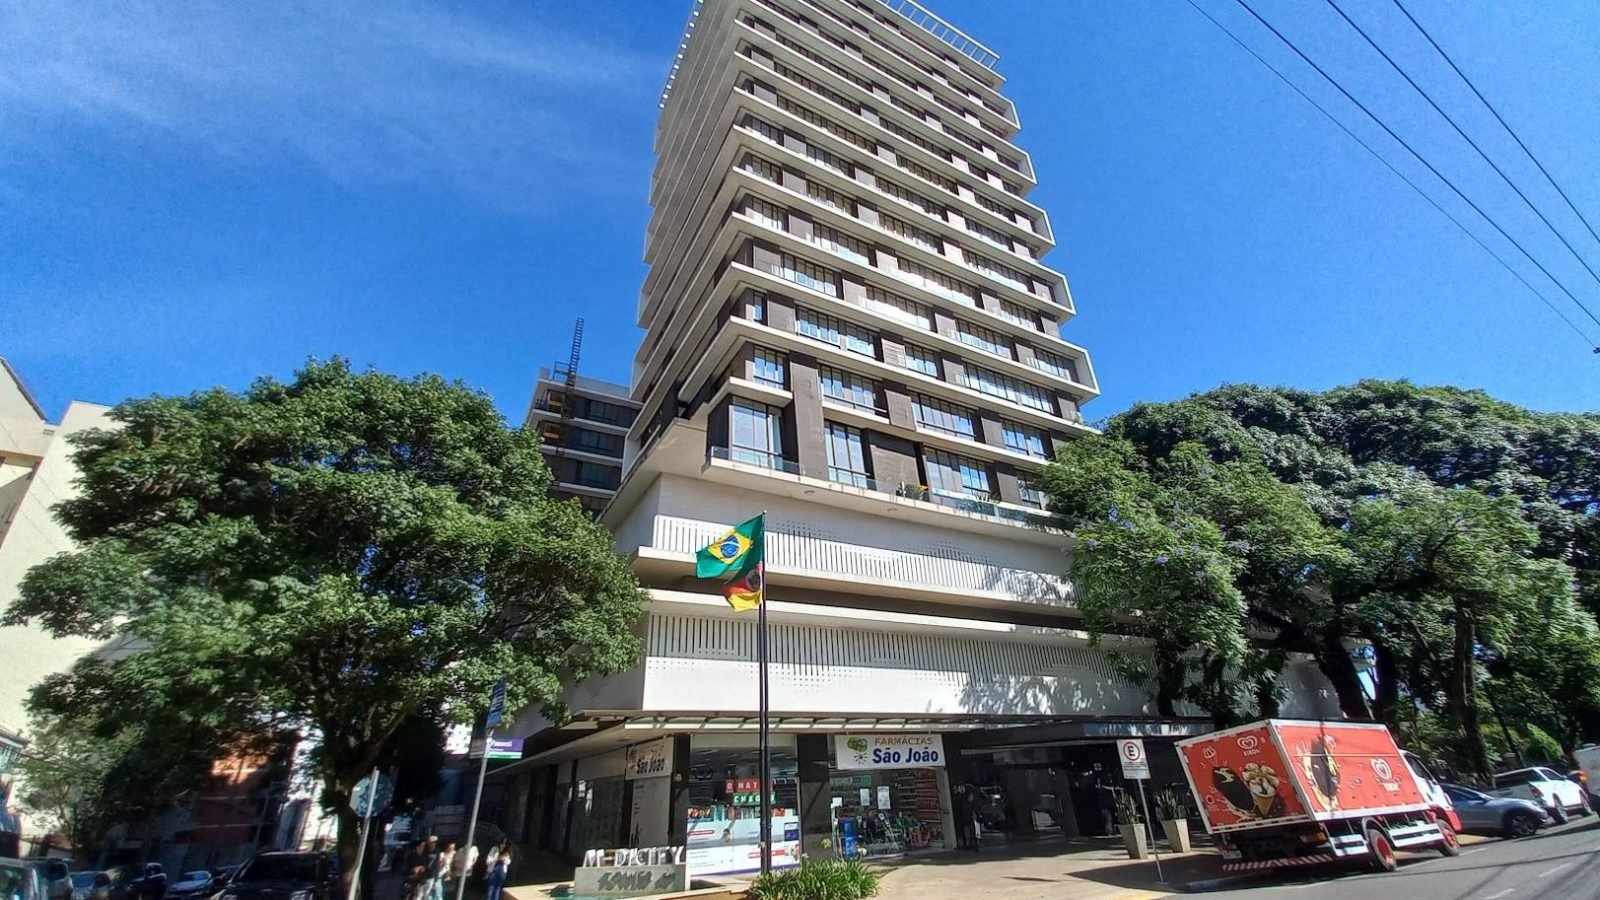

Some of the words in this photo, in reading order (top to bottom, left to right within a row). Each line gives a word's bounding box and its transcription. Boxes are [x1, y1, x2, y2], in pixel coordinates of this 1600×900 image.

[874, 736, 933, 745] FARMÁCIAS
[872, 747, 900, 763] São
[905, 746, 938, 763] João
[1127, 745, 1136, 756] E
